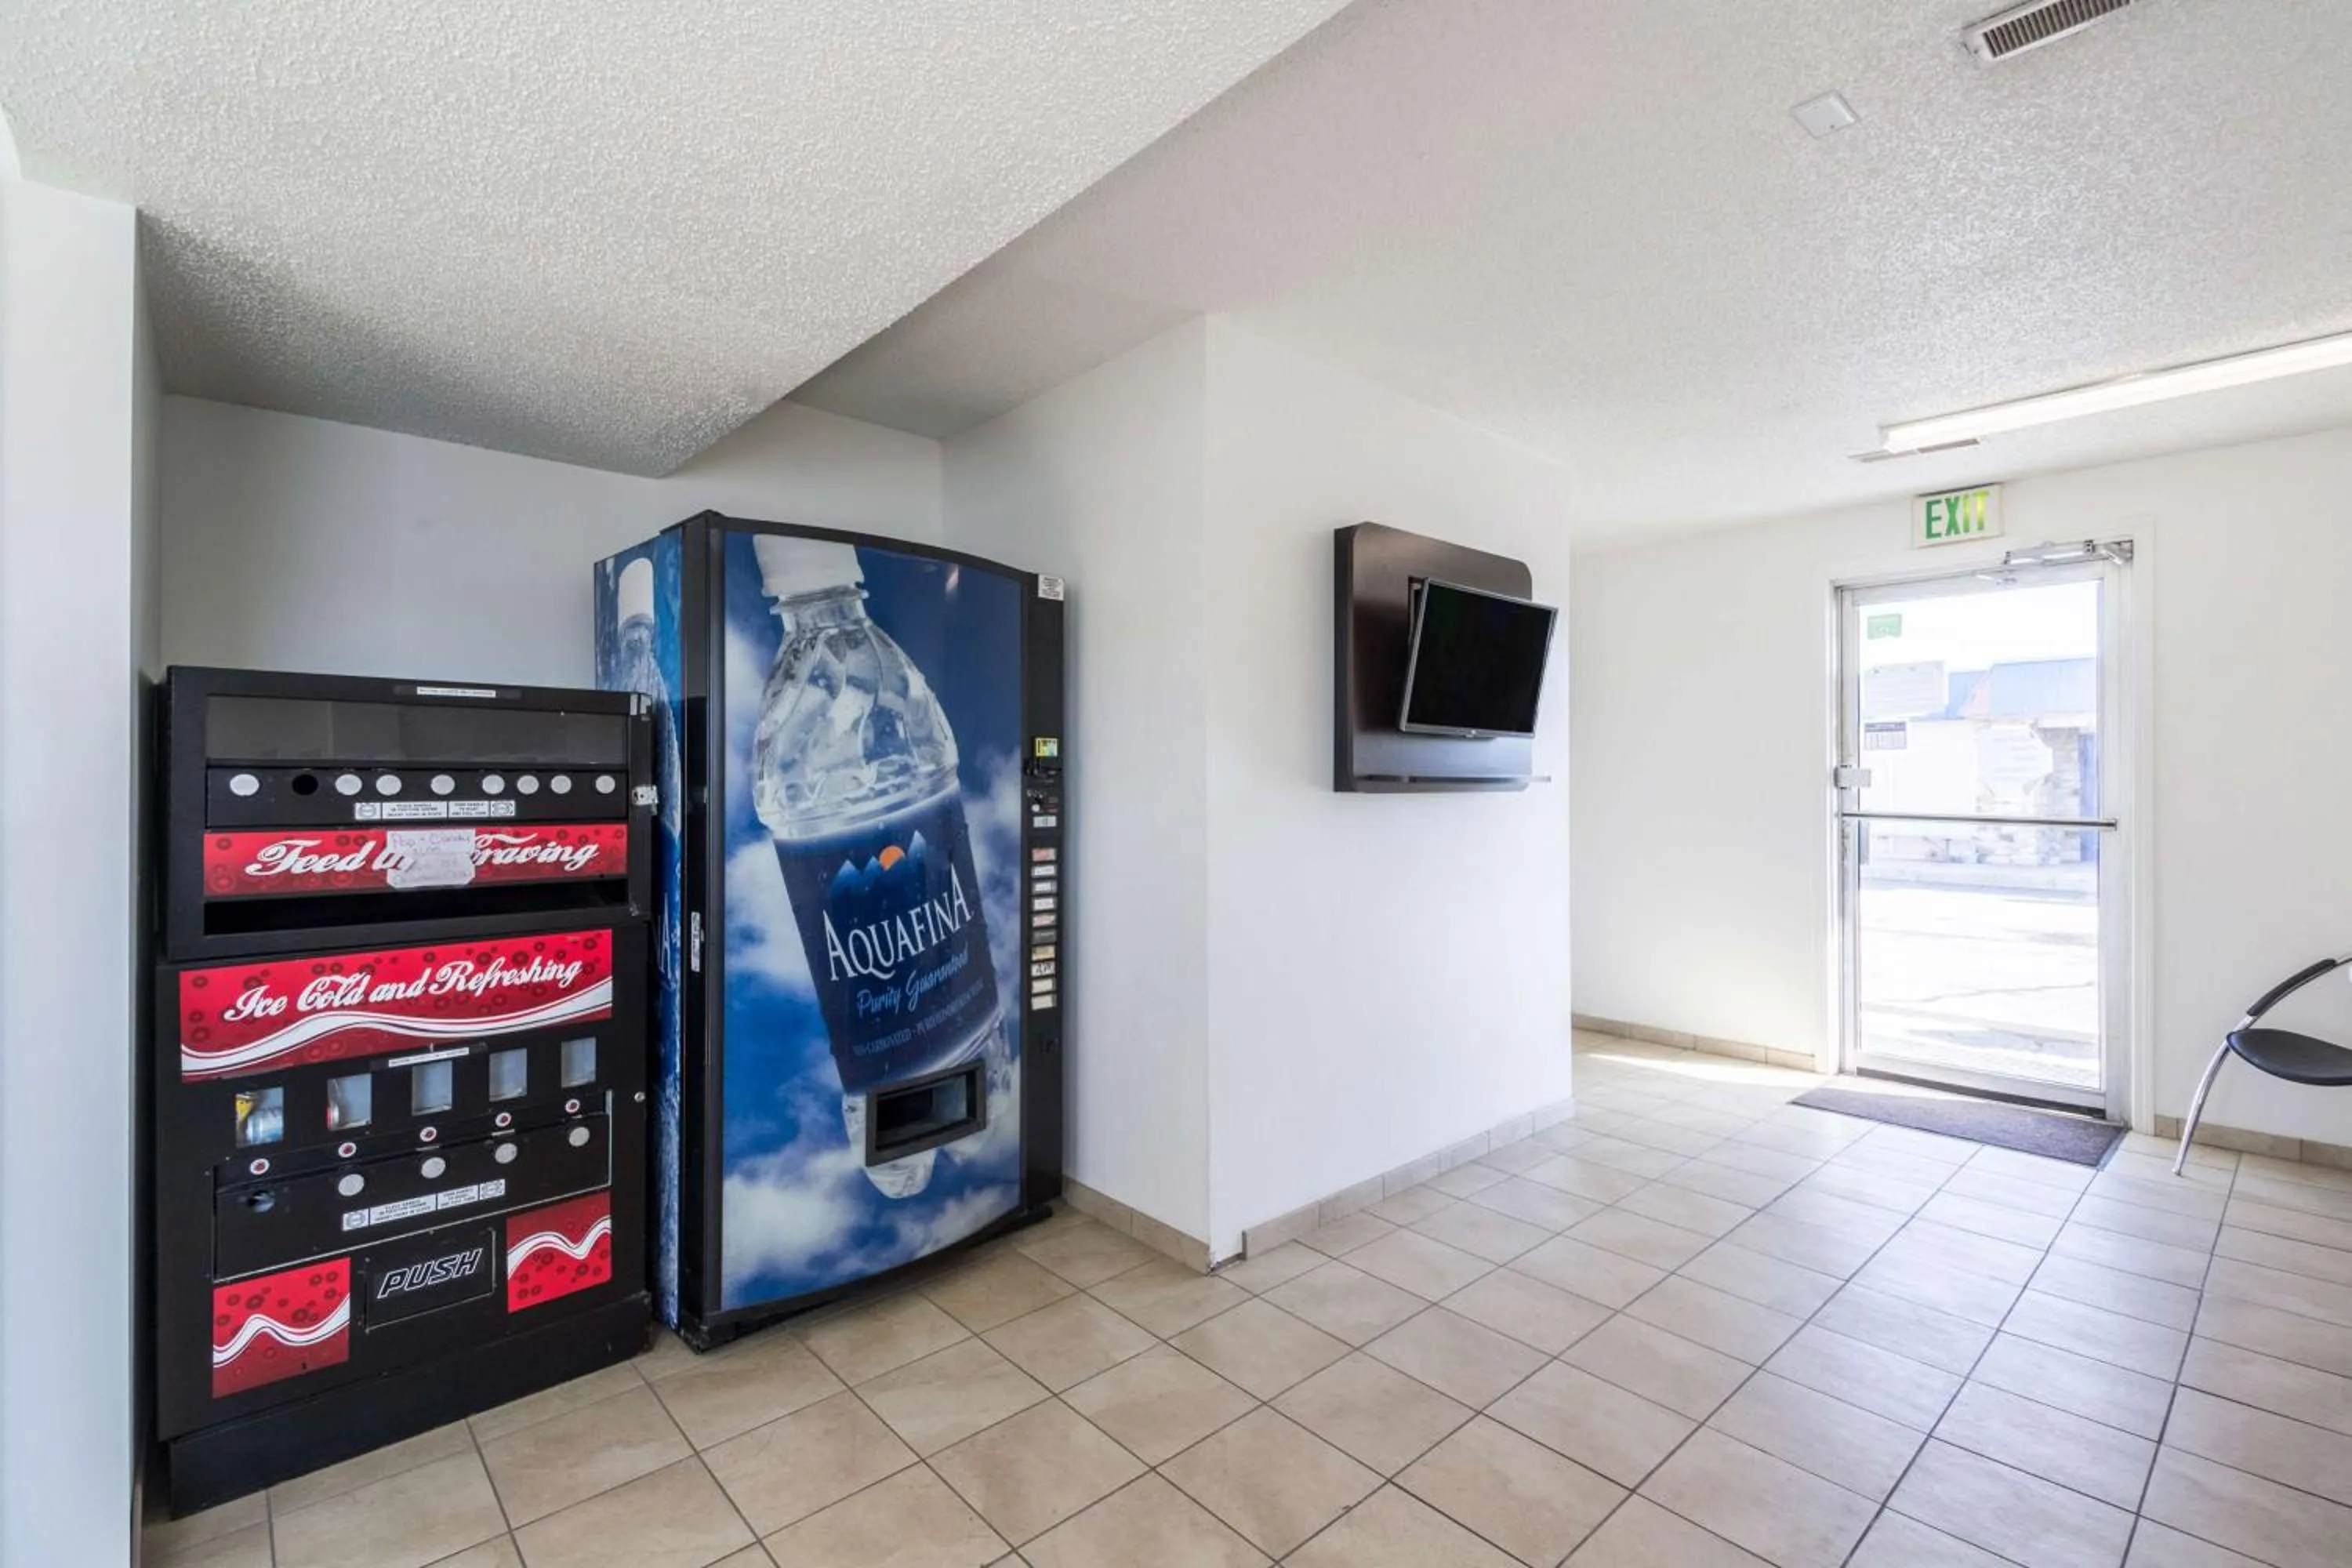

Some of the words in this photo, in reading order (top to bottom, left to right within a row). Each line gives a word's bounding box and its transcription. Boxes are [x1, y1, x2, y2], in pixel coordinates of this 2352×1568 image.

[1925, 490, 1990, 539] EXIT
[245, 840, 376, 876] Feed
[822, 864, 971, 981] AQUAFINA
[223, 985, 288, 1021] Ice
[296, 972, 371, 1011] Cold
[368, 967, 432, 1002] and
[428, 956, 583, 997] Refreshing
[857, 986, 901, 1018] Purity
[377, 1248, 483, 1298] PUSH
